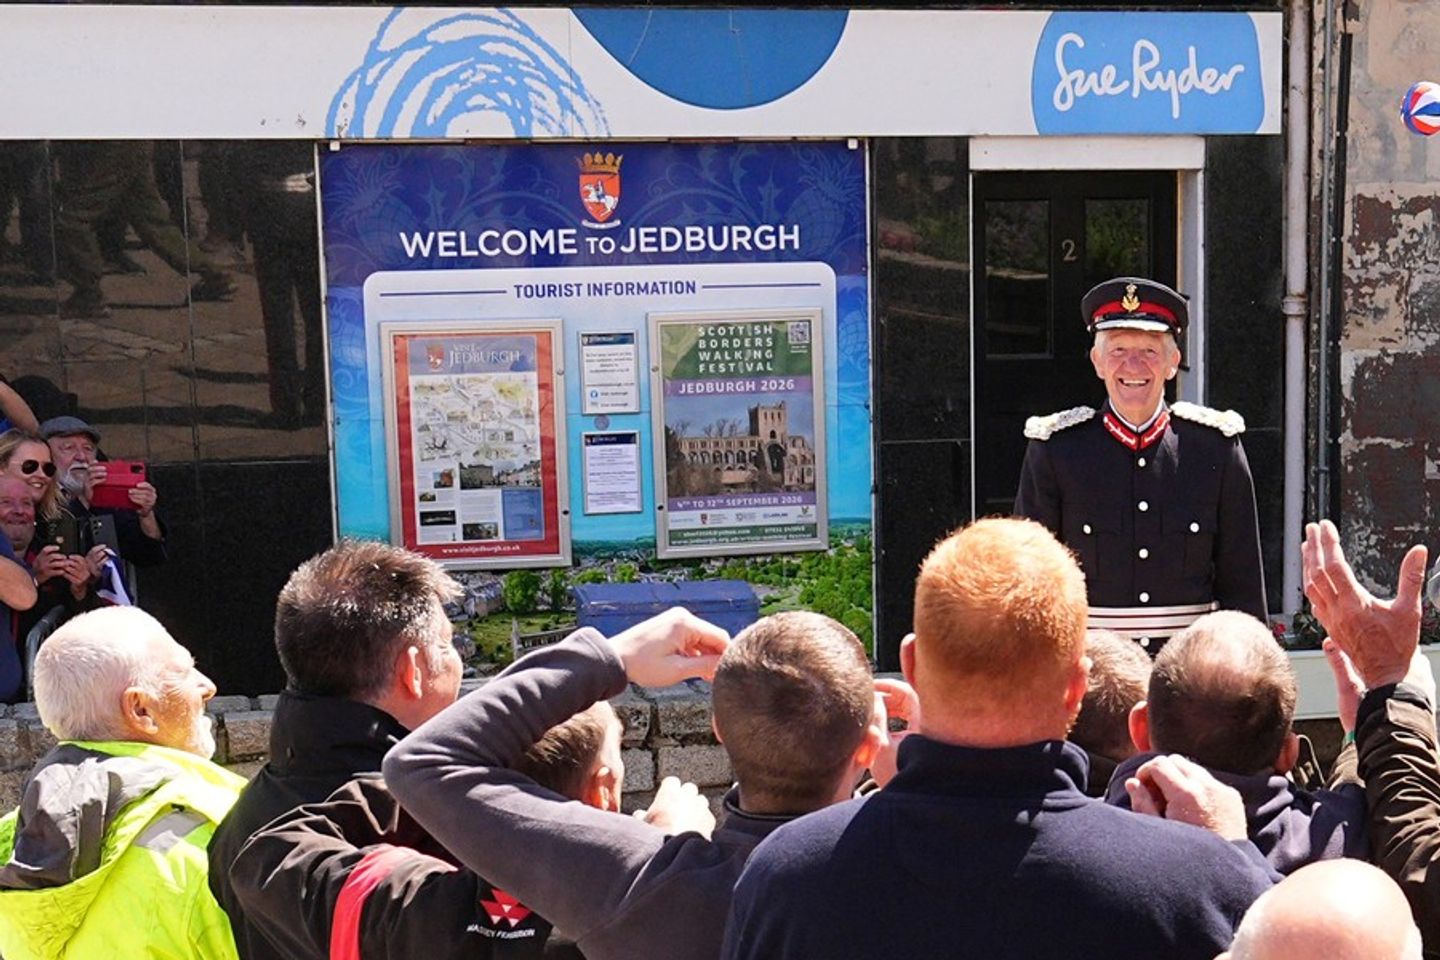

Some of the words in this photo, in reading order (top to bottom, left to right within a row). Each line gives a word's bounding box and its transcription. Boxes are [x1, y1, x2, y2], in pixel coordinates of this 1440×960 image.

[1053, 32, 1130, 112] Sue
[1131, 39, 1245, 119] Ryder
[400, 229, 577, 258] WELCOME
[586, 237, 616, 254] TO
[620, 224, 800, 254] JEDBURGH
[1062, 239, 1077, 261] 2
[513, 283, 583, 299] TOURIST
[587, 280, 696, 297] INFORMATION
[698, 324, 773, 337] SCOTTISH
[698, 337, 773, 349] BORDERS
[450, 350, 520, 367] JEDBURGH
[698, 349, 773, 361] WALKING
[698, 361, 773, 373] FESTIVAL
[679, 380, 755, 394] JEDBURGH
[761, 379, 795, 391] 2026
[726, 497, 778, 506] SEPTEMBER
[781, 495, 803, 504] 2026
